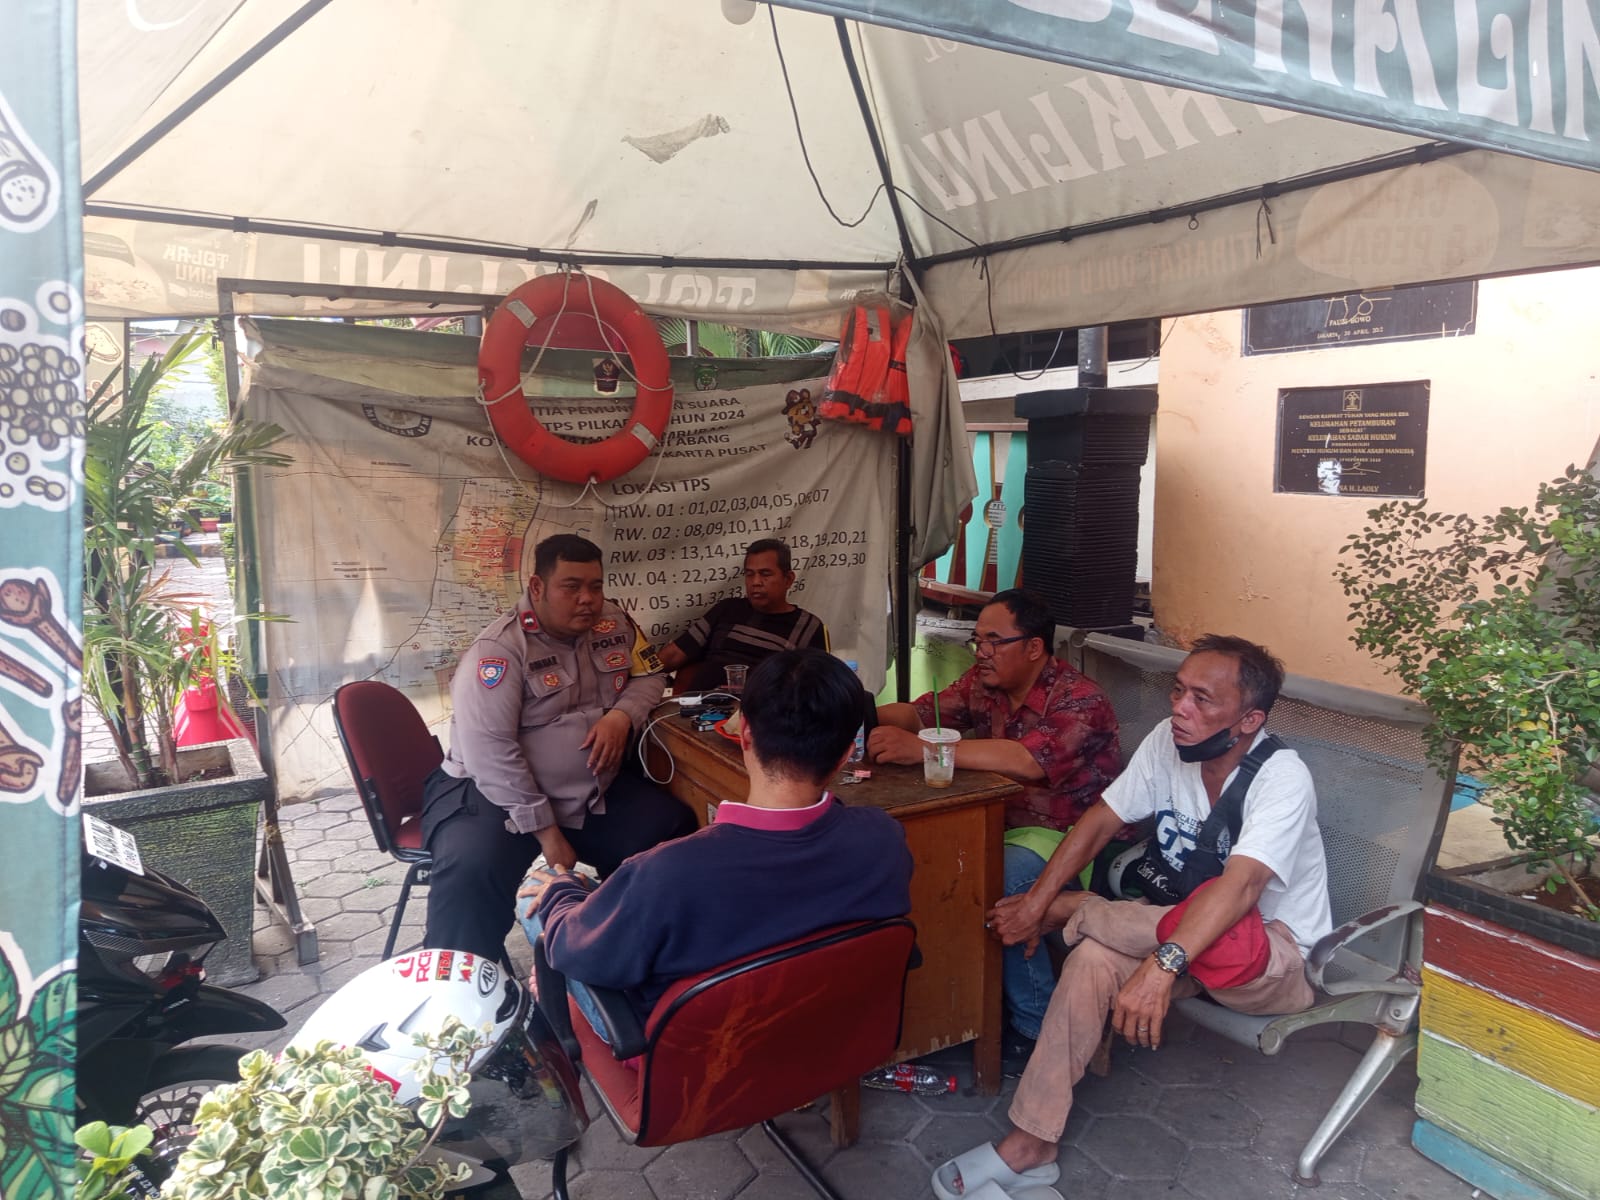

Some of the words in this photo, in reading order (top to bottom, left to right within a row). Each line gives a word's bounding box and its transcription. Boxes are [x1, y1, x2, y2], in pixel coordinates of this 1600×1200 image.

[686, 397, 741, 410] SUARA
[543, 421, 574, 432] TPS
[670, 413, 706, 426] HUN
[710, 409, 745, 422] 2024
[1349, 418, 1396, 427] PETAMBURAN
[676, 434, 731, 446] ABANG
[717, 443, 769, 458] PUSAT
[612, 481, 677, 496] LOKASI
[683, 478, 711, 492] TPS
[655, 503, 675, 518] 01
[614, 526, 647, 541] RW.
[652, 526, 671, 540] 02
[610, 549, 643, 564] RW.
[647, 548, 666, 561] 03
[608, 571, 642, 587] RW.
[646, 571, 667, 586] 04
[649, 595, 670, 610] 05
[651, 622, 671, 637] 06
[591, 635, 626, 652] POLRI
